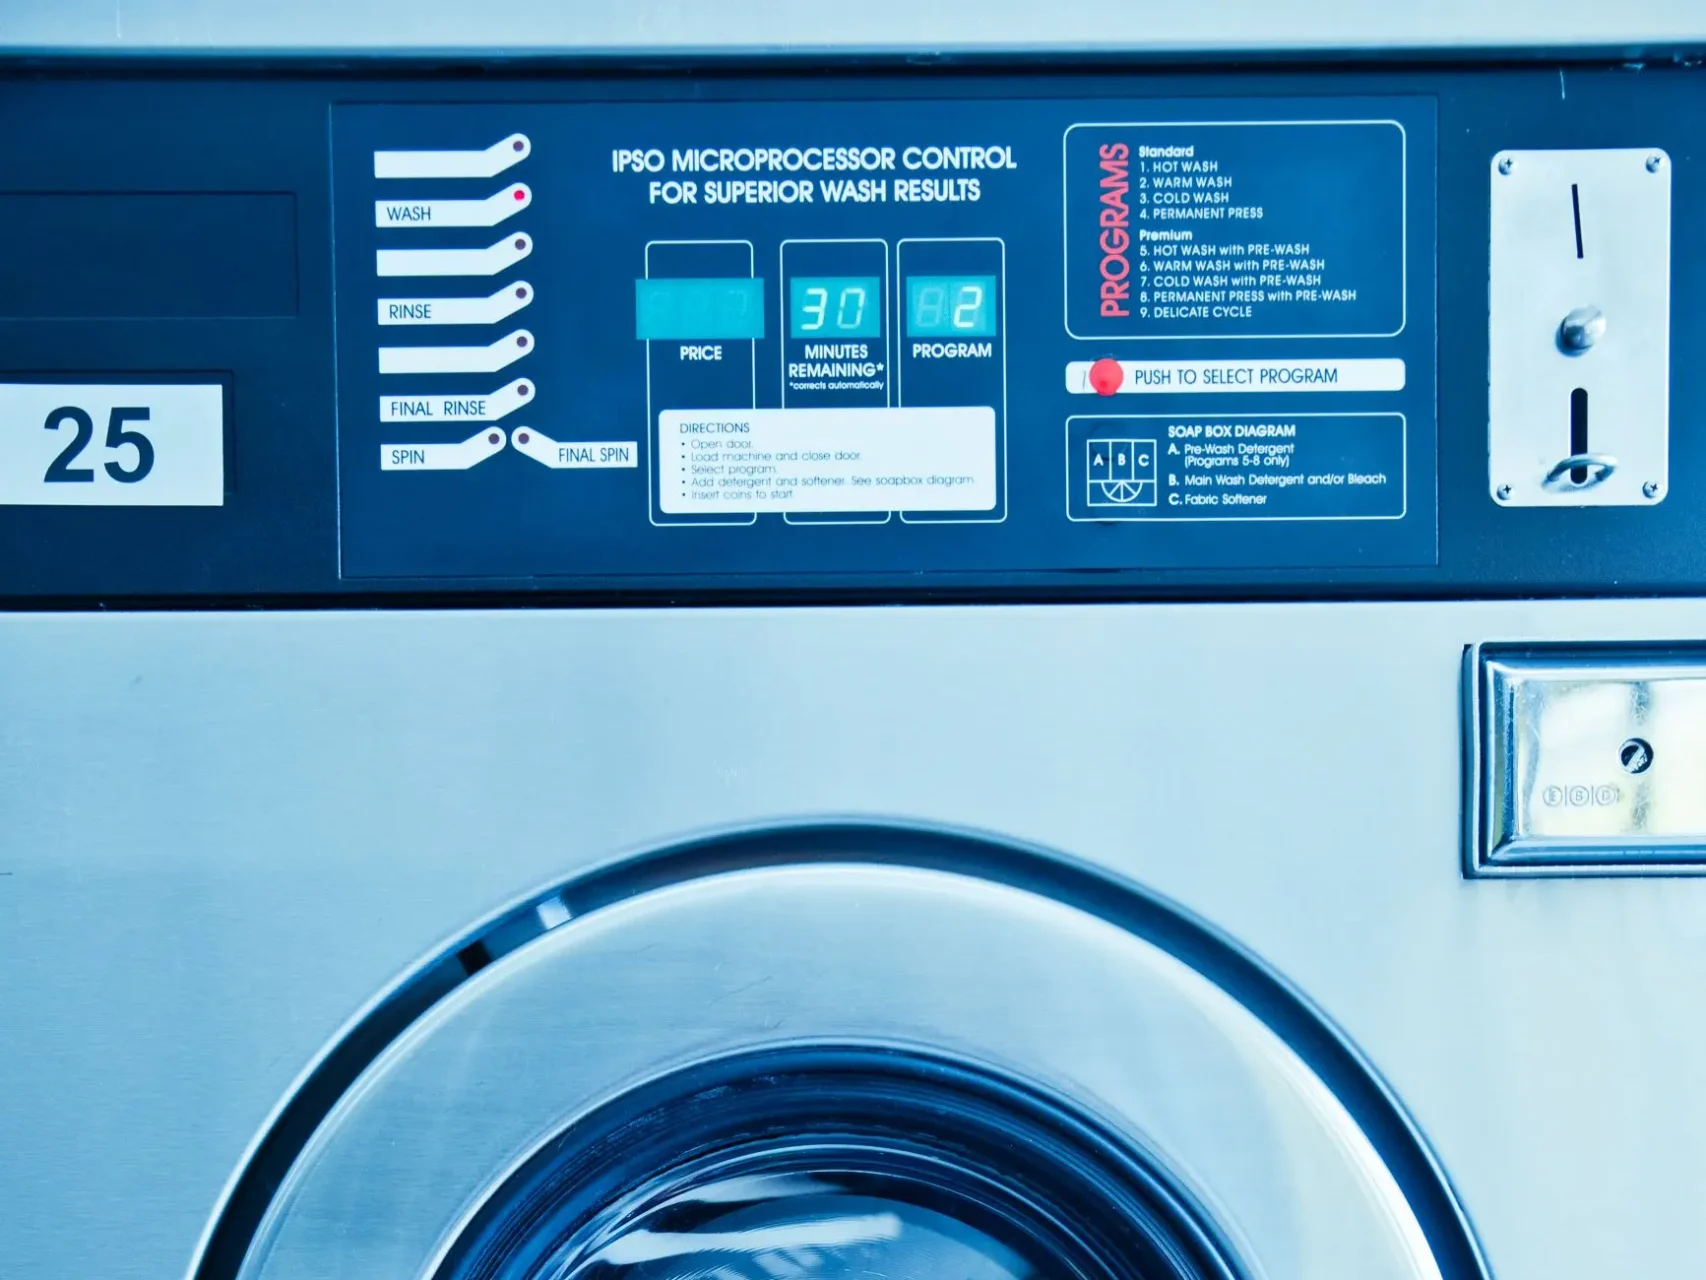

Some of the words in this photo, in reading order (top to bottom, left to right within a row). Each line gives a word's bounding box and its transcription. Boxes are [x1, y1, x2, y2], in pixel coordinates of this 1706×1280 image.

[1139, 146, 1194, 157] Standard
[612, 149, 665, 172] IPSO
[672, 148, 895, 171] MICROPROCESSOR
[902, 146, 1017, 170] CONTROL
[1140, 162, 1150, 173] 1.
[1153, 161, 1178, 173] HOT
[1181, 161, 1218, 172] WASH
[1139, 177, 1150, 188] 2.
[1152, 177, 1193, 188] WARM
[1196, 176, 1233, 188] WASH
[649, 181, 697, 204] FOR
[704, 180, 814, 203] SUPERIOR
[819, 180, 887, 202] WASH
[894, 179, 980, 201] RESULTS
[1139, 193, 1150, 204] 3.
[1153, 192, 1190, 204] COLD
[1193, 192, 1229, 203] WASH
[386, 206, 432, 221] WASH
[1139, 209, 1150, 219] 4.
[1153, 208, 1224, 219] PERMANENT
[1228, 207, 1263, 219] PRESS
[1099, 143, 1130, 317] PROGRAMS
[1139, 229, 1193, 241] Premium
[1140, 245, 1150, 256] 5.
[1153, 245, 1179, 256] HOT
[1181, 244, 1217, 256] WASH
[1219, 244, 1245, 255] with
[1248, 243, 1310, 255] PRE-WASH
[1140, 261, 1150, 272] 6.
[1153, 260, 1194, 272] WARM
[1196, 260, 1231, 271] WASH
[1234, 260, 1260, 271] with
[1262, 259, 1325, 271] PRE-WASH
[1140, 276, 1150, 287] 7.
[1153, 276, 1191, 287] COLD
[1193, 275, 1228, 287] WASH
[1230, 275, 1257, 286] with
[1259, 275, 1322, 286] PRE-WASH
[1140, 292, 1150, 303] 8.
[1153, 291, 1226, 302] PERMANENT
[1229, 290, 1265, 302] PRESS
[1267, 290, 1293, 301] with
[1296, 289, 1357, 301] PRE-WASH
[388, 303, 432, 319] RINSE
[801, 287, 865, 330] 30
[953, 286, 982, 328] 2
[1140, 307, 1150, 318] 9.
[1153, 307, 1209, 318] DELICATE
[1212, 306, 1252, 318] CYCLE
[680, 346, 722, 360] PRICE
[805, 345, 868, 359] MINUTES
[912, 343, 992, 358] PROGRAM
[1135, 370, 1171, 385] PUSH
[1177, 369, 1197, 384] TO
[1203, 369, 1254, 384] SELECT
[1260, 368, 1338, 384] PROGRAM
[828, 381, 884, 391] automatically
[390, 400, 434, 416] FINAL
[443, 399, 487, 416] RINSE
[680, 423, 750, 433] DIRECTIONS
[1168, 426, 1203, 438] SOAP
[1205, 426, 1233, 437] BOX
[1235, 425, 1296, 437] DIAGRAM
[43, 405, 156, 483] 25
[691, 439, 722, 450] Open
[726, 439, 753, 449] door.
[1168, 444, 1181, 455] A.
[1184, 444, 1235, 454] Pre-Wash
[1238, 443, 1294, 456] Detergent
[391, 449, 425, 465] SPIN
[558, 447, 596, 463] FINAL
[600, 447, 630, 463] SPIN
[691, 453, 718, 462] Load
[722, 452, 771, 461] machine
[776, 452, 798, 461] and
[801, 451, 830, 461] close
[835, 451, 861, 460] door.
[1094, 454, 1103, 466] A
[1118, 454, 1126, 465] B
[1138, 454, 1149, 466] C
[1184, 456, 1239, 468] (Programs
[1242, 455, 1261, 466] 5-8
[1264, 455, 1290, 467] only)
[691, 465, 724, 474] Select
[728, 466, 777, 476] program.
[692, 477, 714, 487] Add
[718, 477, 772, 488] detergent
[776, 477, 798, 486] and
[801, 476, 847, 486] softener.
[851, 476, 871, 485] See
[876, 475, 922, 487] soapbox
[927, 475, 975, 487] diagram.
[1169, 475, 1180, 485] B.
[1185, 474, 1213, 485] Main
[1215, 474, 1246, 485] Wash
[1249, 474, 1305, 487] Detergent
[1307, 473, 1345, 485] and/or
[1348, 473, 1386, 484] Bleach
[692, 490, 719, 499] Insert
[723, 490, 752, 499] coins
[756, 490, 766, 499] to
[1169, 494, 1183, 505] C.
[1185, 494, 1218, 505] Fabric
[1222, 493, 1267, 505] Softener
